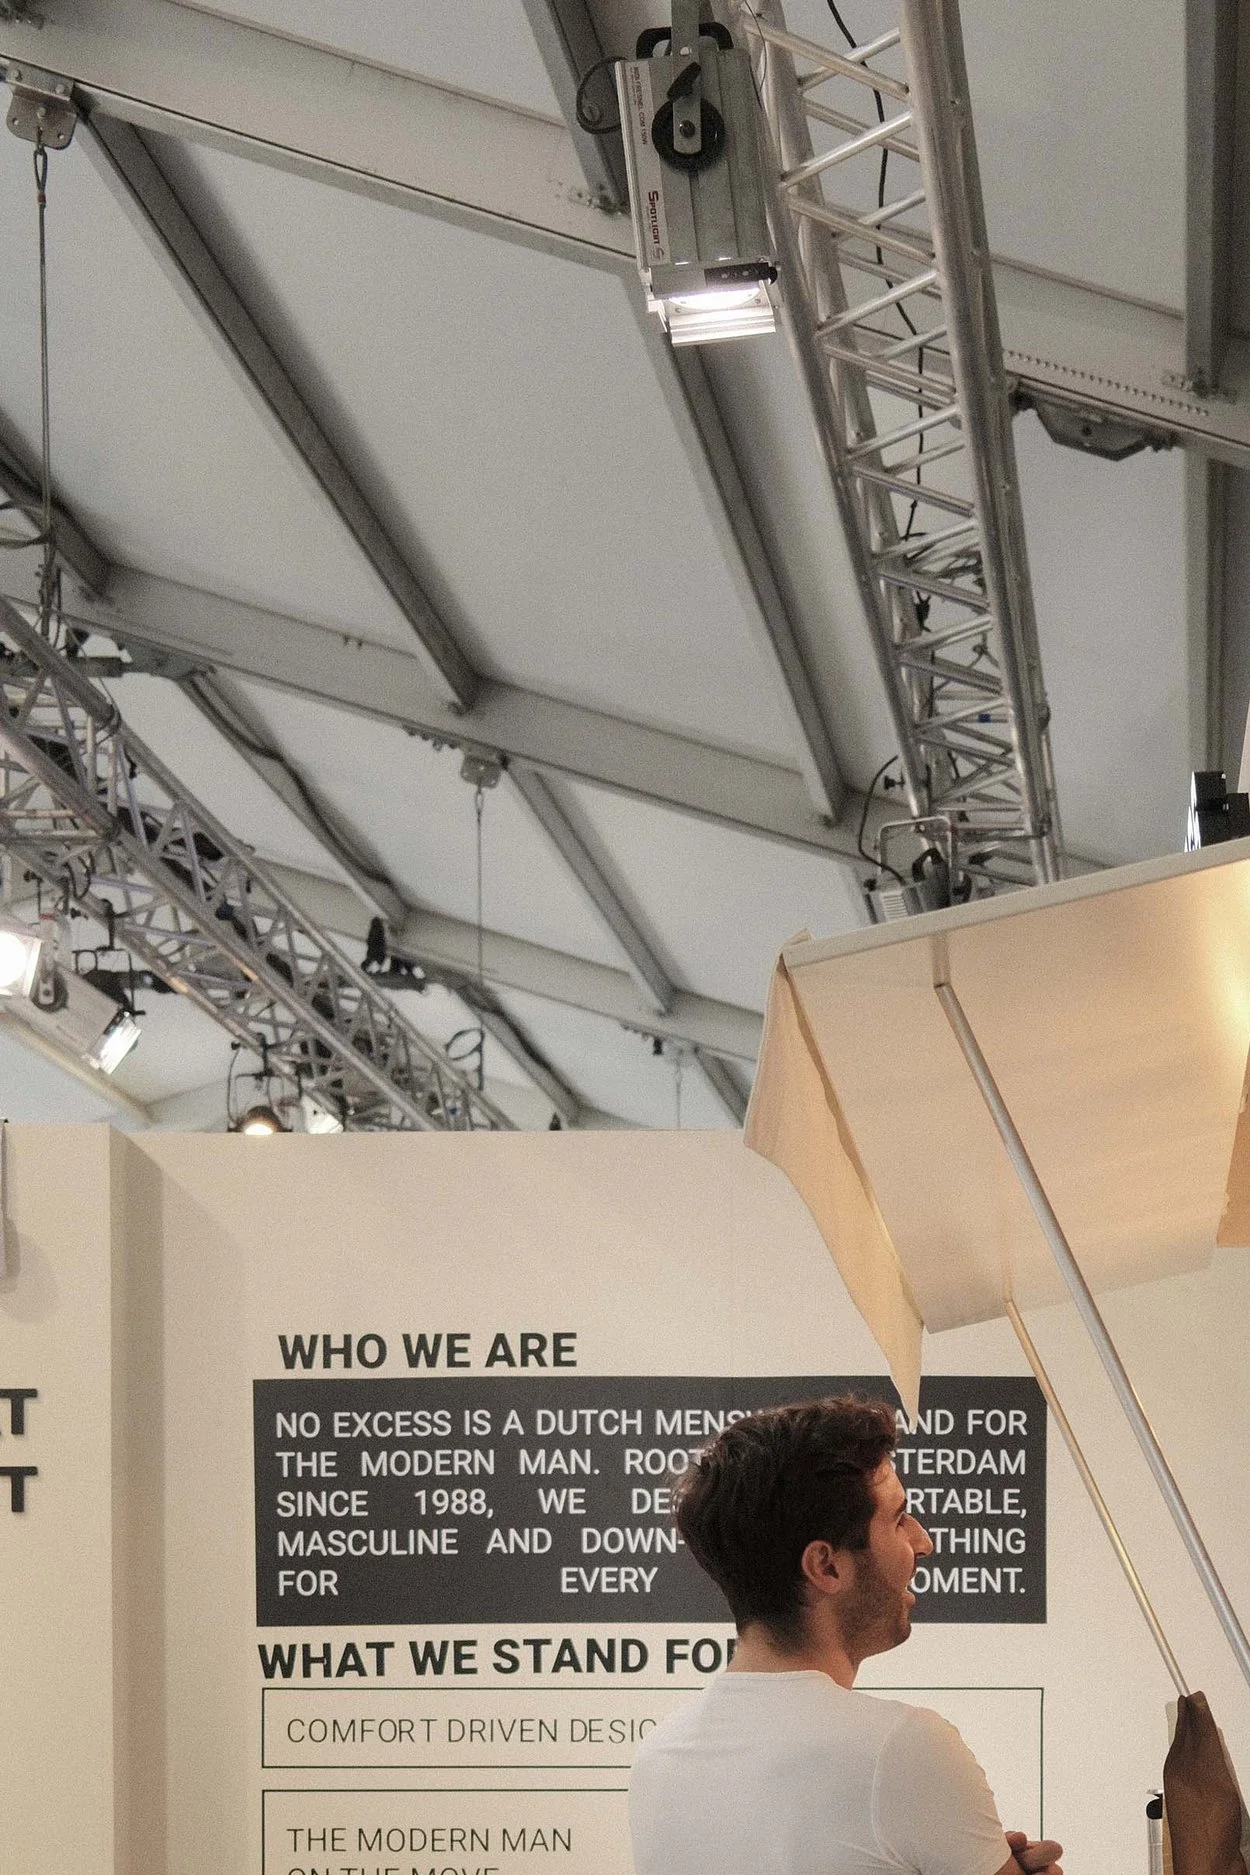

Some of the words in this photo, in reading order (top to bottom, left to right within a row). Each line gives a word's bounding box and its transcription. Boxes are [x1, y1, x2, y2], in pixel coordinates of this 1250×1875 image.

[279, 1334, 386, 1369] WHO
[403, 1333, 470, 1368] WE
[485, 1333, 576, 1367] ARE
[0, 1388, 38, 1434] T
[277, 1412, 320, 1438] NO
[334, 1410, 451, 1437] EXCESS
[465, 1410, 491, 1435] IS
[503, 1410, 524, 1435] A
[537, 1409, 641, 1435] DUTCH
[656, 1410, 752, 1434] MENS
[894, 1410, 954, 1435] AND
[968, 1410, 1027, 1435] FOR
[276, 1452, 337, 1477] THE
[362, 1449, 494, 1476] MODERN
[520, 1449, 599, 1474] MAN.
[624, 1448, 706, 1475] ROOT
[893, 1449, 1026, 1475] TERDAM
[277, 1491, 368, 1517] SINCE
[415, 1489, 493, 1518] 1988,
[538, 1489, 585, 1514] WE
[631, 1488, 671, 1514] DE
[906, 1488, 1027, 1519] RTABLE,
[279, 1529, 458, 1556] MASCULINE
[487, 1528, 552, 1553] AND
[581, 1528, 685, 1554] DOWN-
[929, 1528, 1026, 1554] THING
[279, 1570, 338, 1596] FOR
[562, 1567, 657, 1592] EVERY
[911, 1567, 1026, 1594] OMENT.
[258, 1642, 394, 1679] WHAT
[409, 1640, 477, 1675] WE
[493, 1639, 648, 1674] STAND
[287, 1719, 436, 1743] COMFORT
[448, 1719, 557, 1742] DRIVEN
[287, 1828, 345, 1852] THE
[358, 1828, 488, 1852] MODERN
[503, 1828, 570, 1851] MAN
